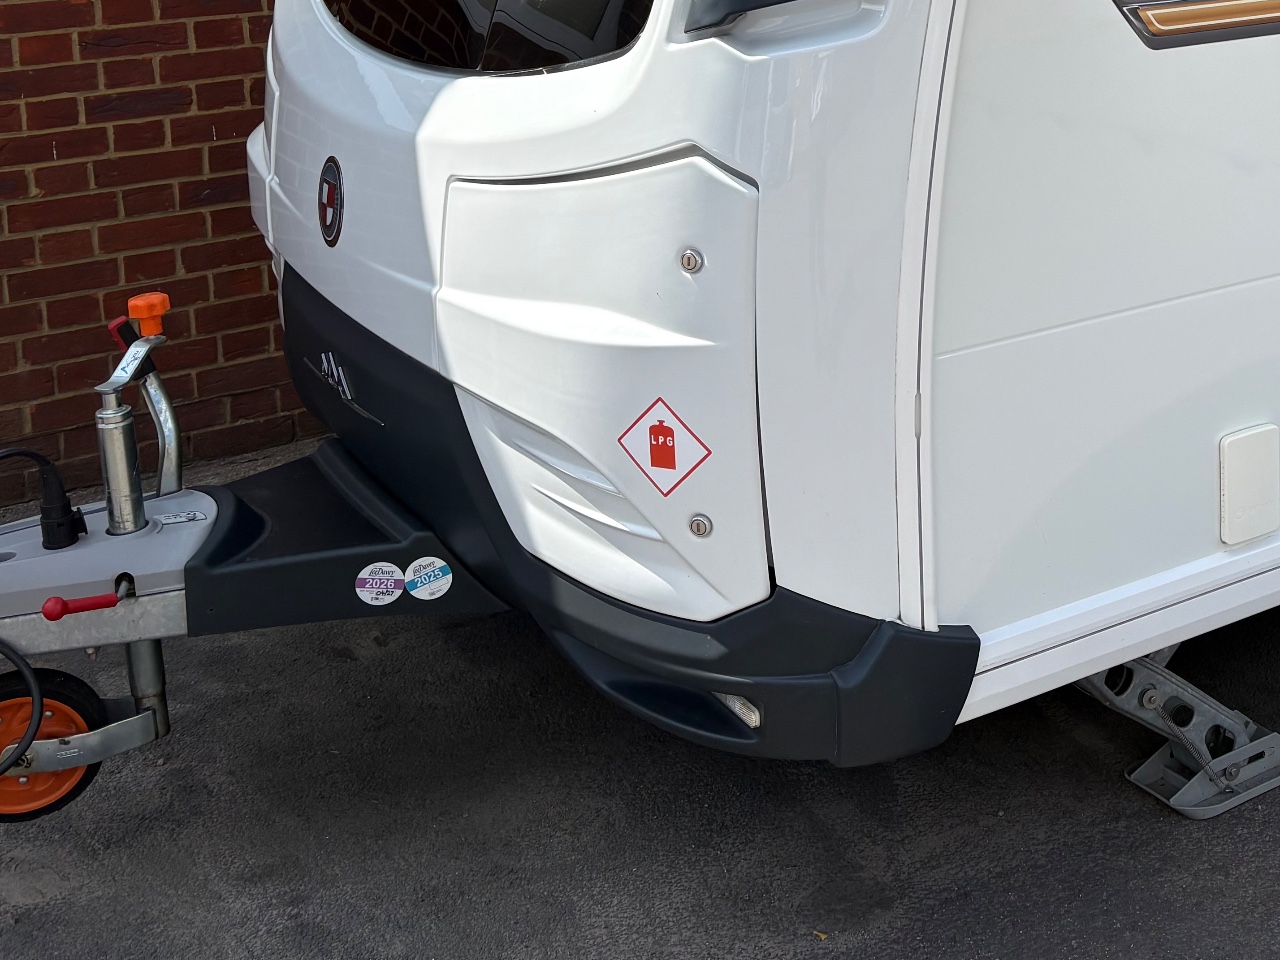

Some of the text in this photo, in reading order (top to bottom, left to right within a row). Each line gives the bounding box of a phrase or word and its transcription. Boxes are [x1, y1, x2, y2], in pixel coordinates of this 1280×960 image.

[651, 434, 673, 446] LPG
[364, 578, 395, 589] 2026
[414, 569, 443, 588] 2025
